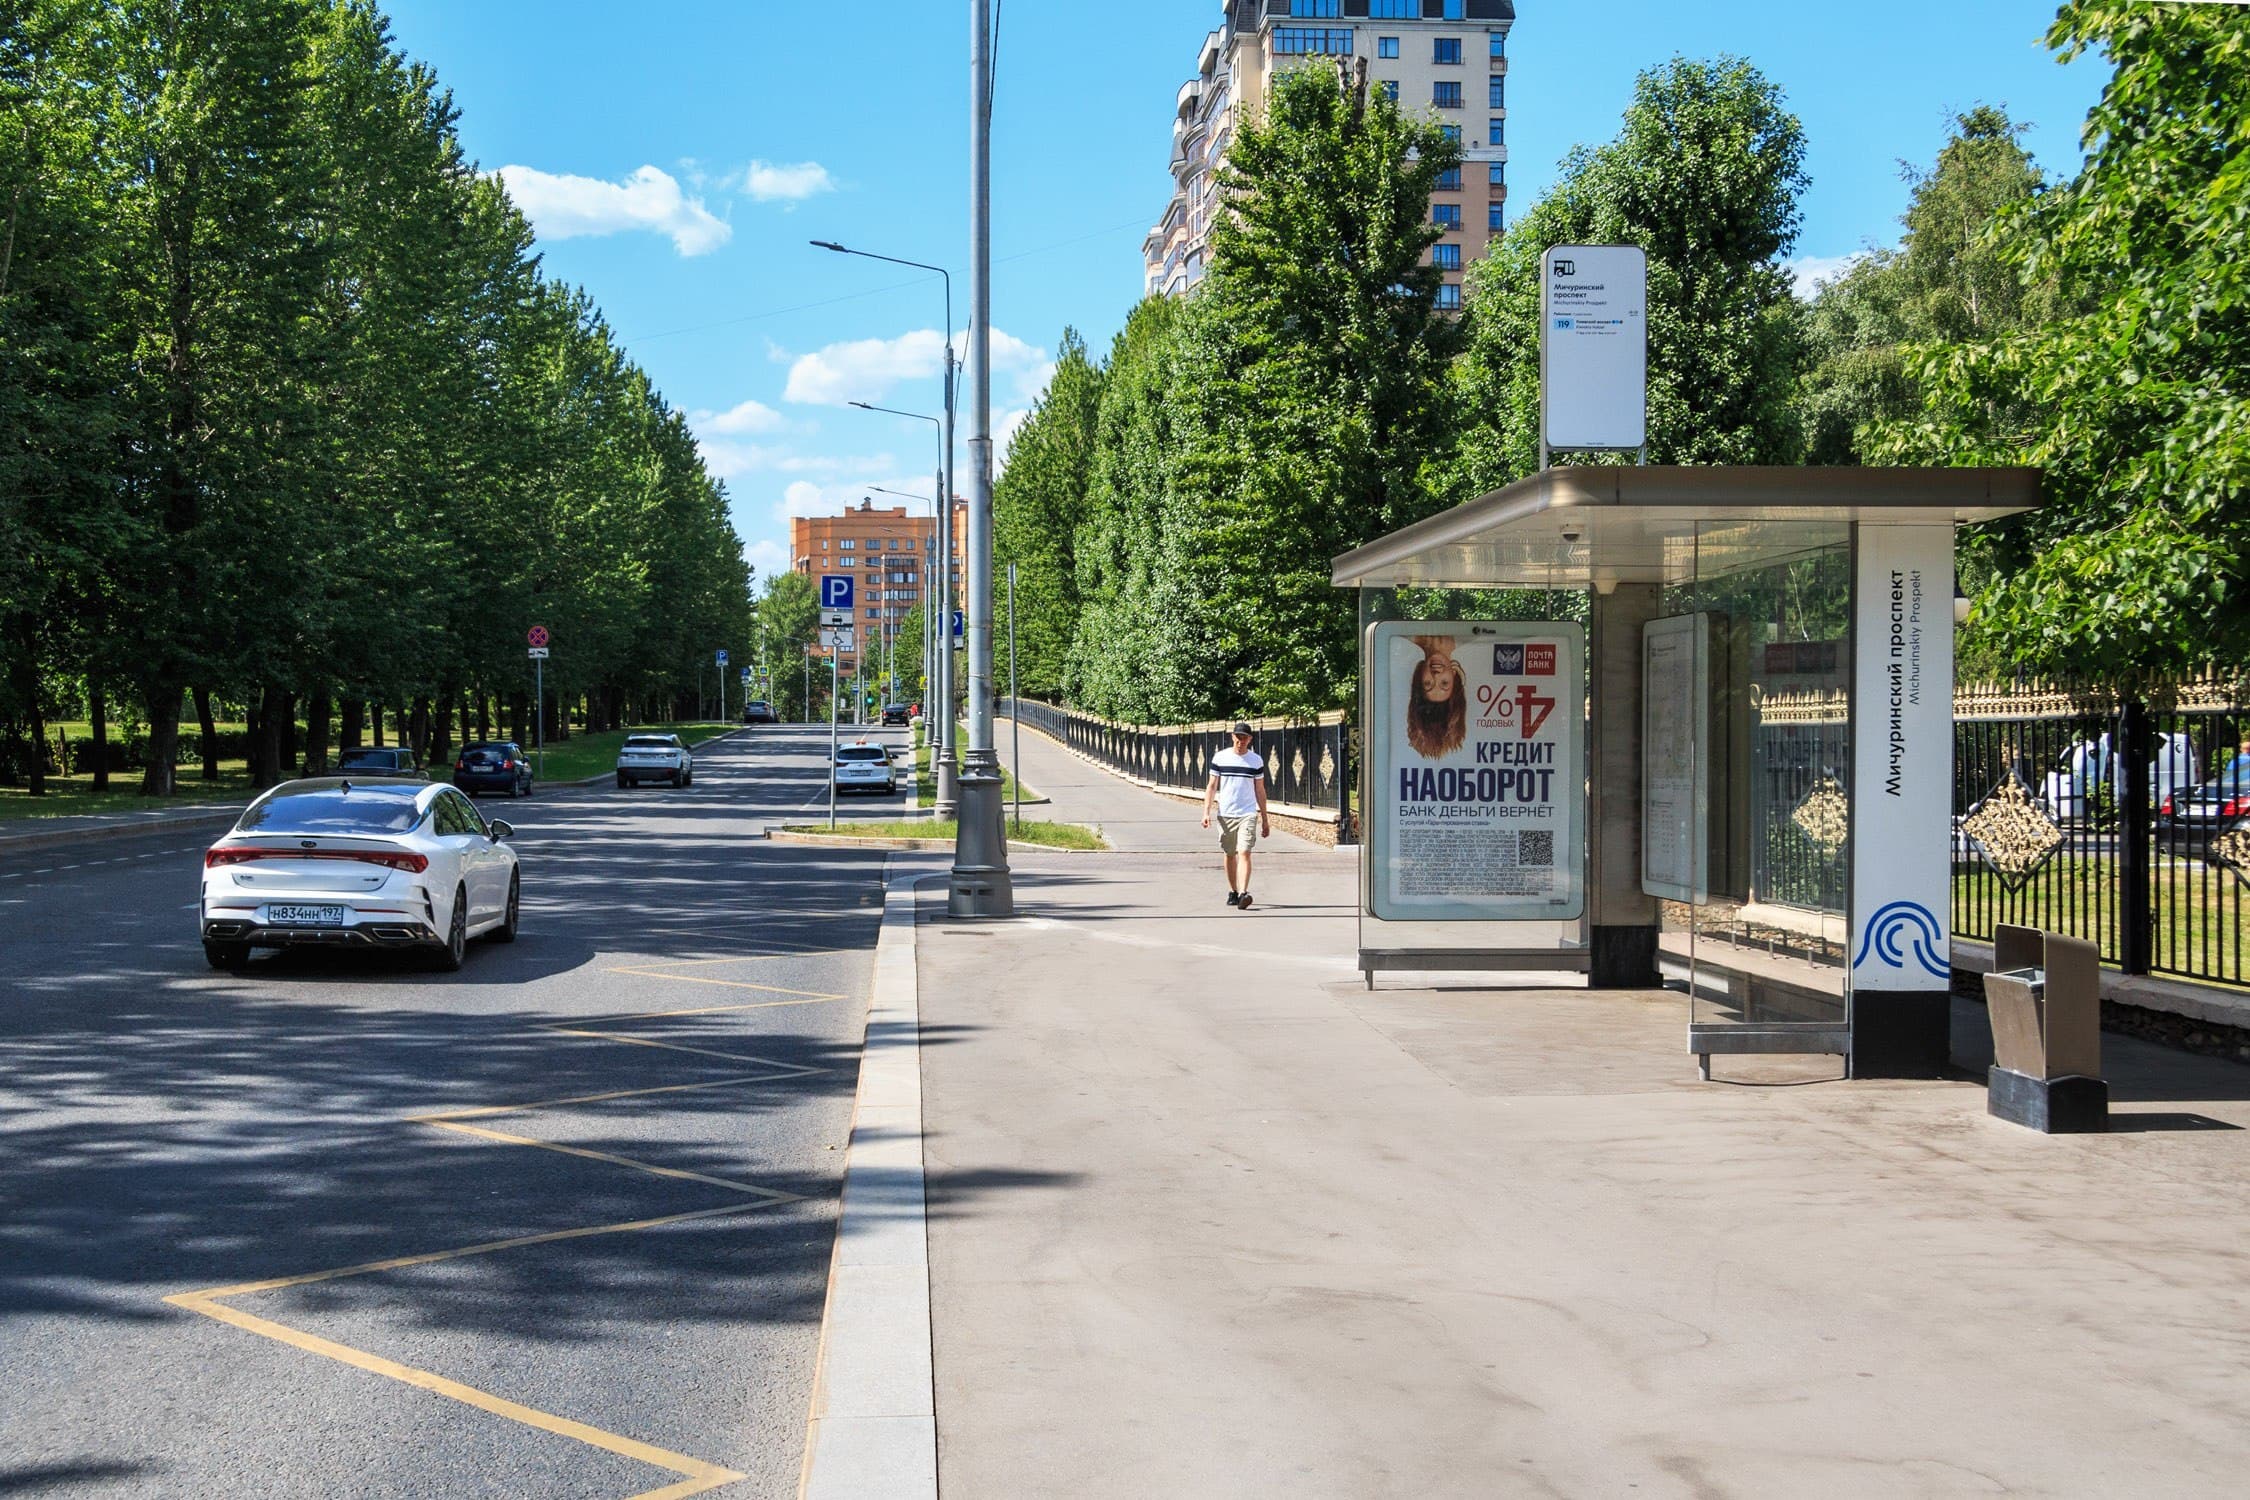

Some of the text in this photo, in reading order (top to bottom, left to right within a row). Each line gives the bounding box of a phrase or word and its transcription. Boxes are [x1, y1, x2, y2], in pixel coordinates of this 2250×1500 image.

[1558, 320, 1570, 328] 119
[830, 579, 848, 605] P
[1909, 570, 1923, 705] Michurinskiy Prospekt
[1528, 651, 1553, 659] ПОЧТА
[1528, 660, 1550, 669] БАНК
[1885, 570, 1906, 797] Мичуринский проспект
[1476, 719, 1514, 728] ГОДОВЫХ
[1476, 742, 1555, 766] КРЕДИТ
[1400, 768, 1555, 802] НАОБОРОТ
[1399, 804, 1555, 818] БАНК ДЕНЬГИ ВЕРНЁТ
[321, 907, 339, 917] 197
